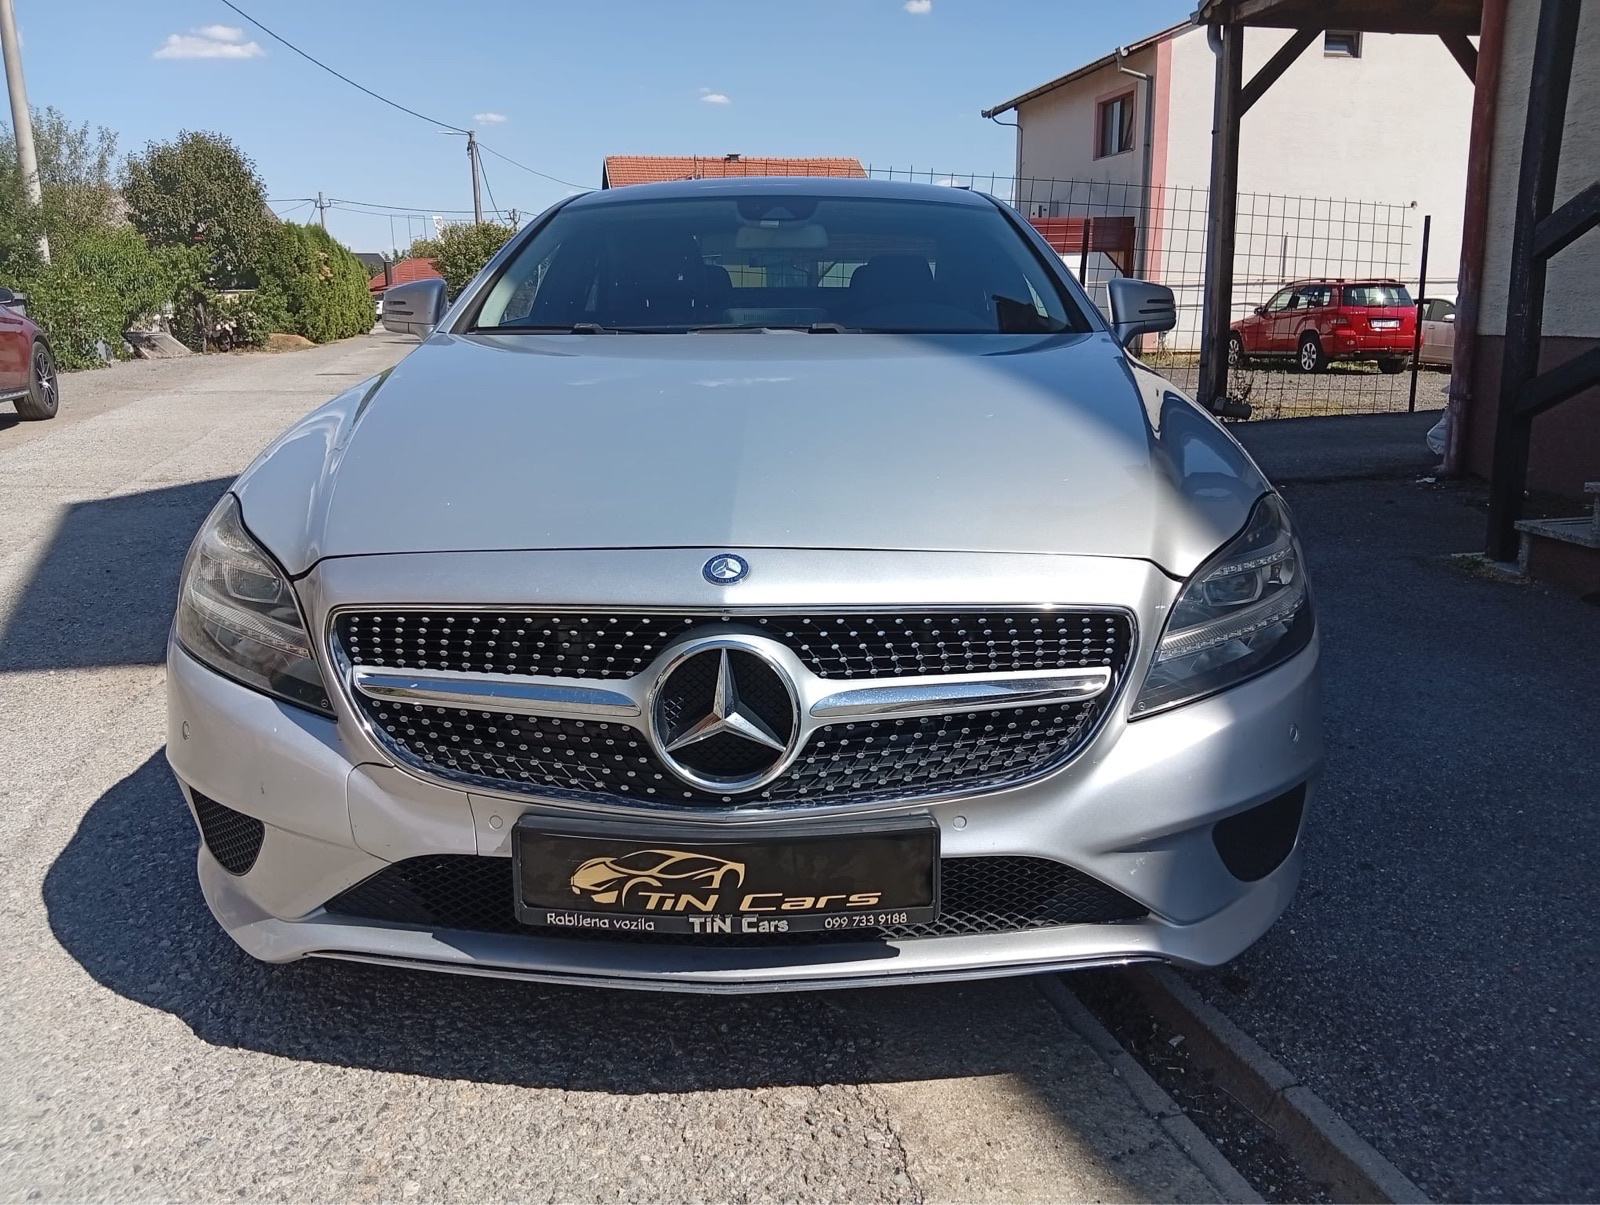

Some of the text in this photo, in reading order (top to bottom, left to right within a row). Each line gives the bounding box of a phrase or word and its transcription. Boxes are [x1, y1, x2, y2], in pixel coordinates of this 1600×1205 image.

[739, 892, 882, 912] Cars
[547, 912, 655, 931] Rabljena vozila
[741, 914, 789, 934] Cars
[824, 912, 908, 929] 099 733 9188
